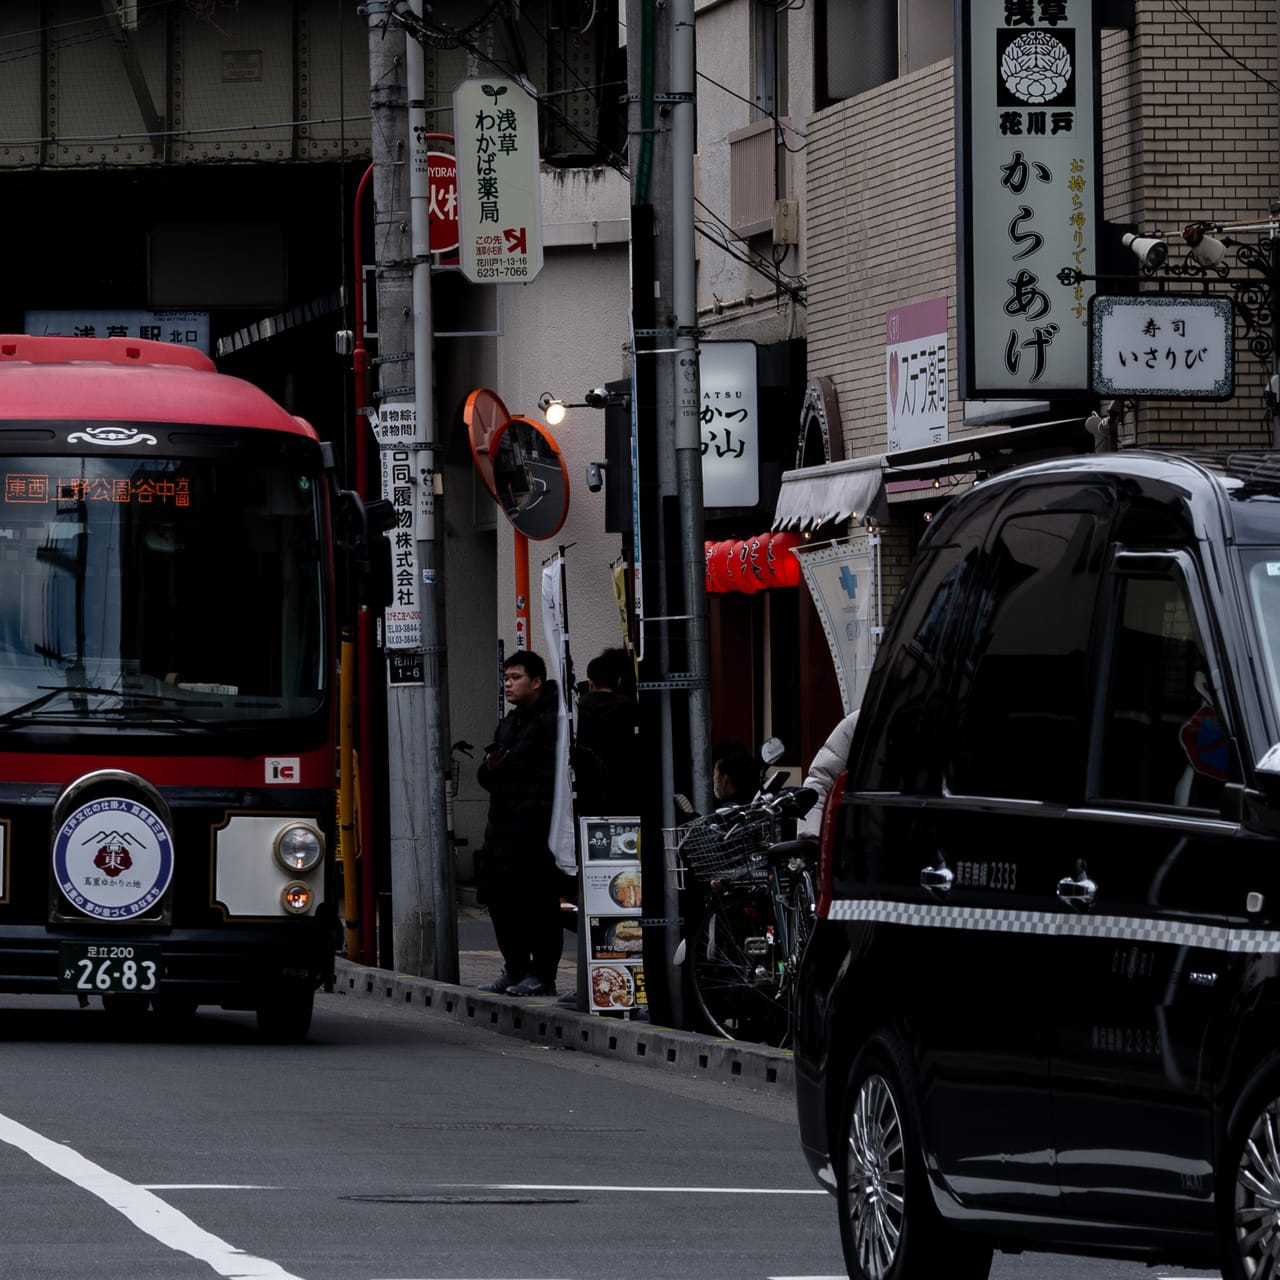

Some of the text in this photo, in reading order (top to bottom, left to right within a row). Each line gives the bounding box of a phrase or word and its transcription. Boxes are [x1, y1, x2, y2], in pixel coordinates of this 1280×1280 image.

[496, 108, 519, 156] 浅草
[999, 111, 1074, 136] 花川戸
[474, 109, 500, 224] わかば薬局
[475, 235, 503, 245] この先
[1067, 158, 1089, 328] お持ち帰りでます。
[477, 266, 528, 278] 6231-7066
[999, 150, 1060, 384] からあげ
[170, 330, 198, 342] 北口
[1142, 317, 1187, 337] 寿司
[1118, 347, 1208, 370] いさりび
[703, 391, 743, 399] ATSU
[398, 667, 421, 678] 1-6
[989, 861, 1017, 892] 2333
[76, 958, 157, 991] 26-83
